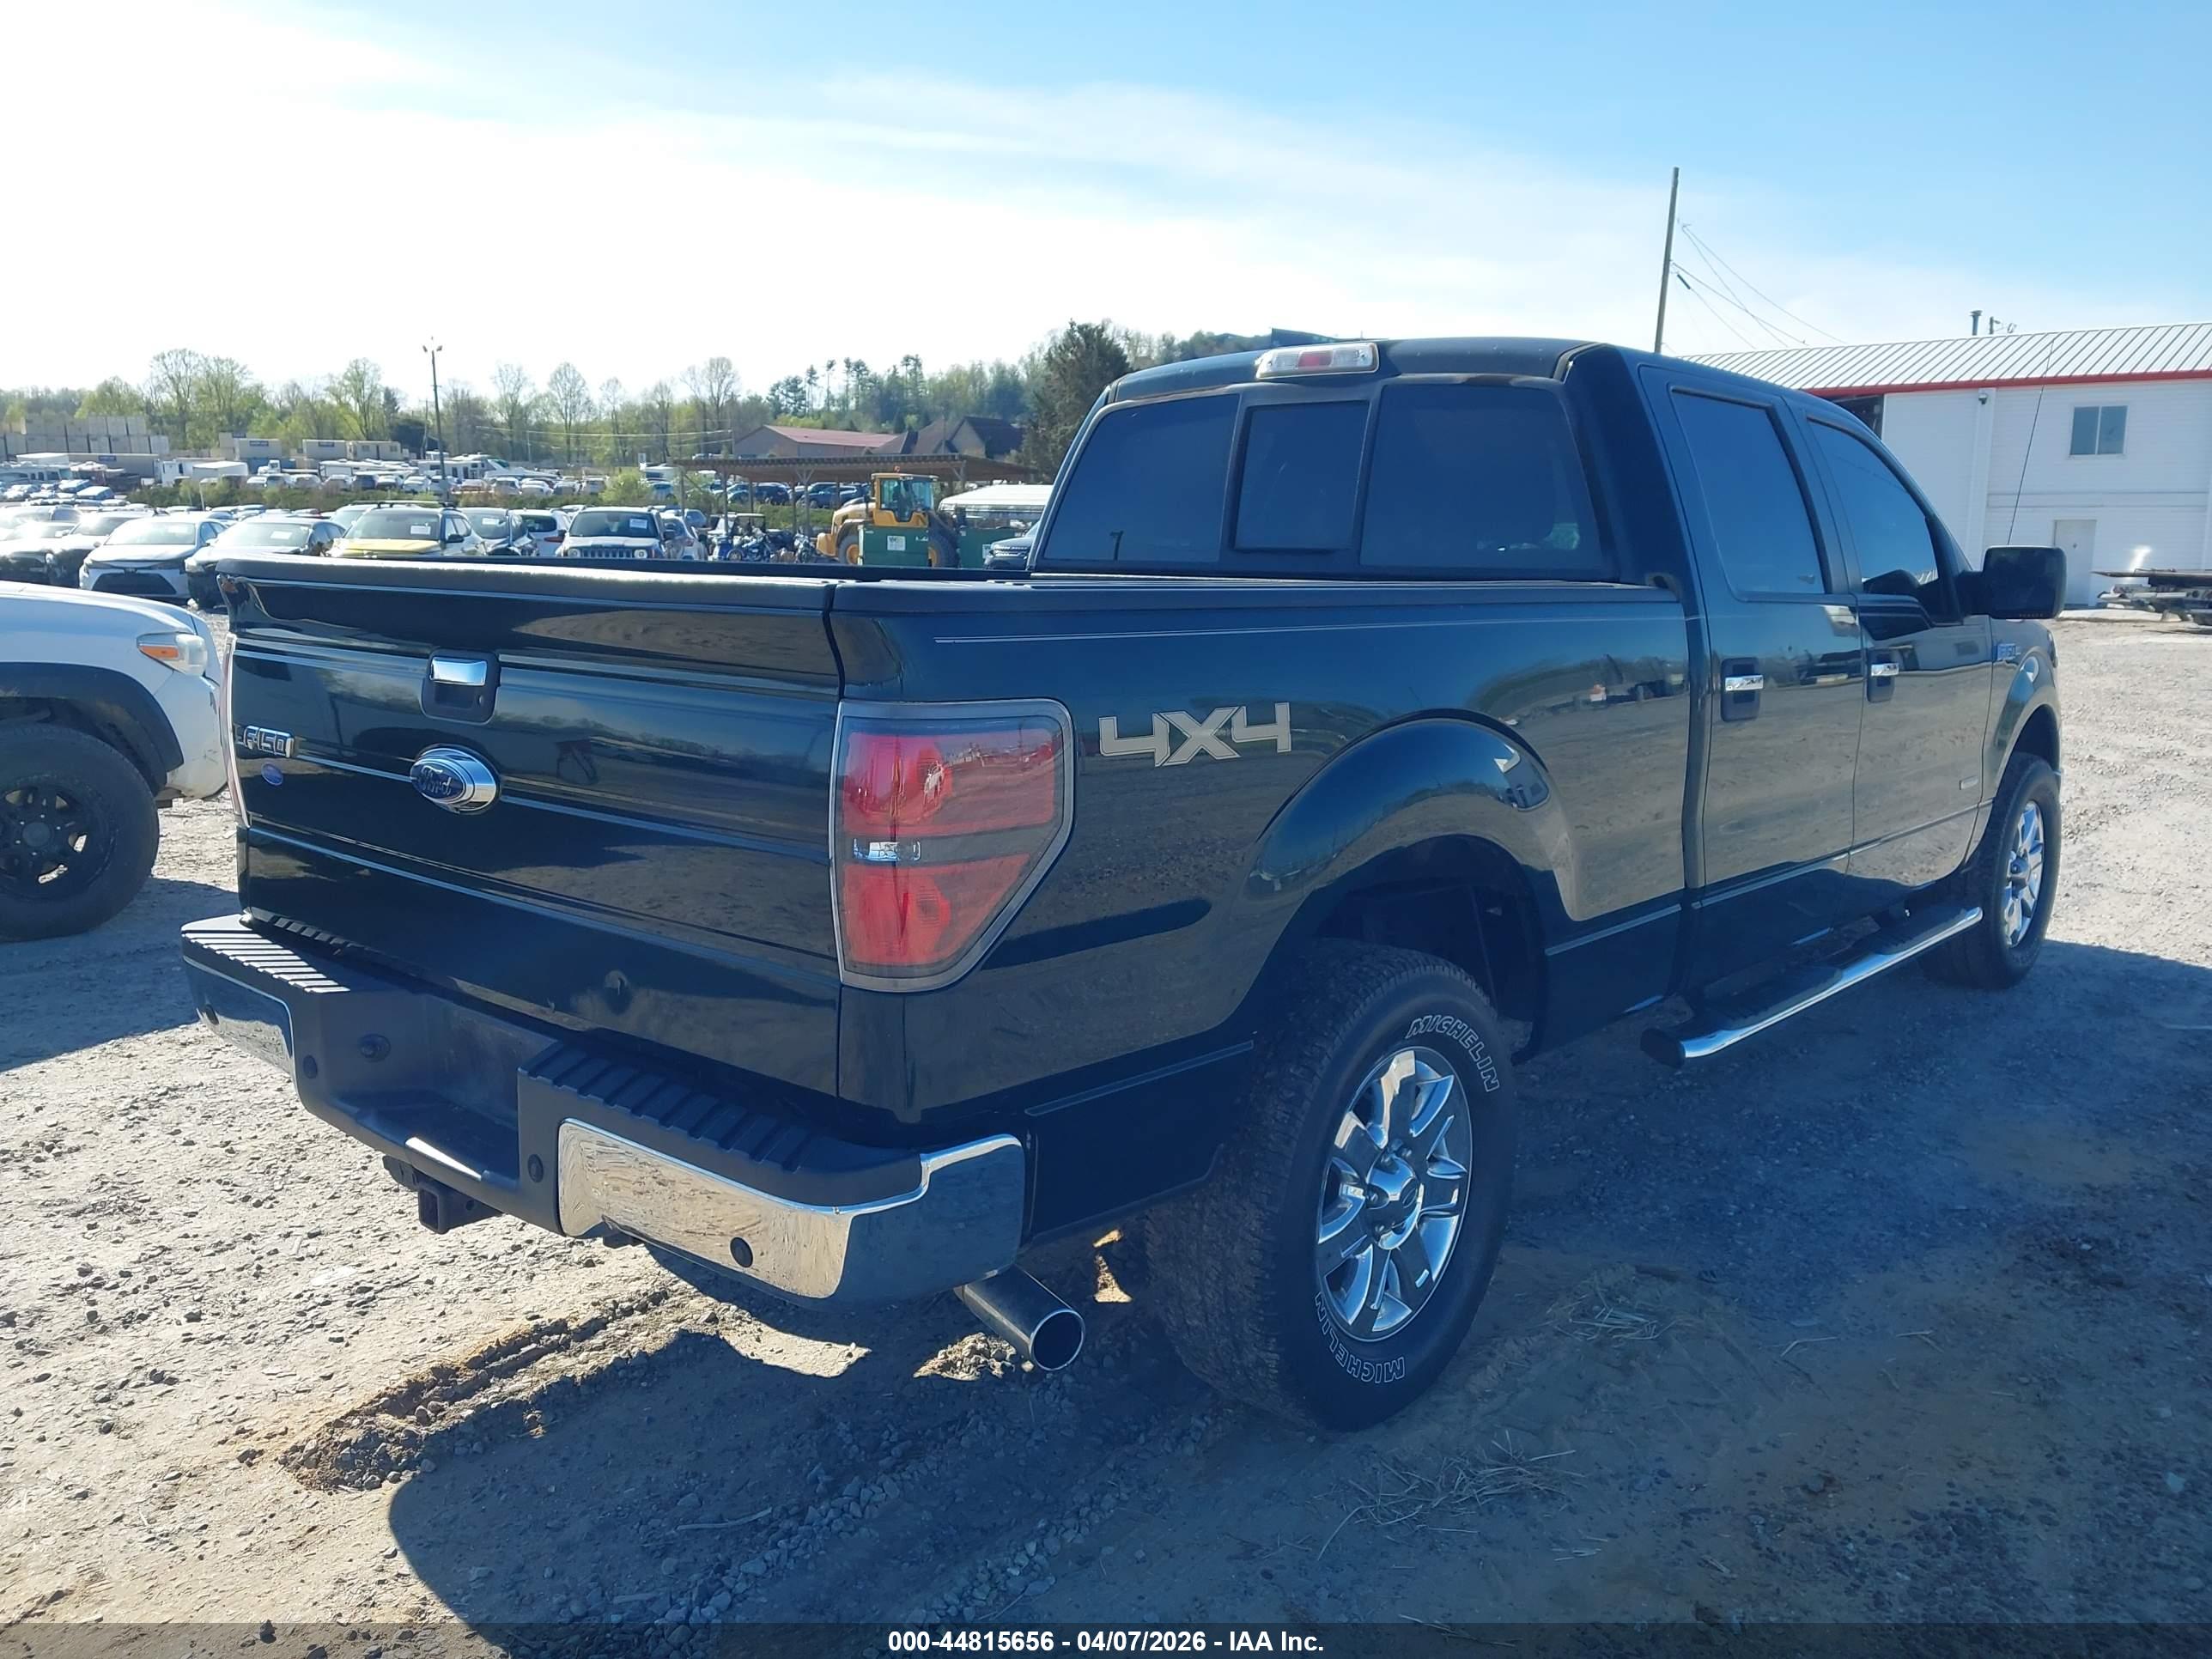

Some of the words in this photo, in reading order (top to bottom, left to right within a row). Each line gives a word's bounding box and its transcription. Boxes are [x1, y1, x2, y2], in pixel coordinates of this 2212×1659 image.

[417, 764, 453, 796] Ford
[1404, 1014, 1500, 1092] MICHELIN
[1314, 1291, 1406, 1384] MICHELIN
